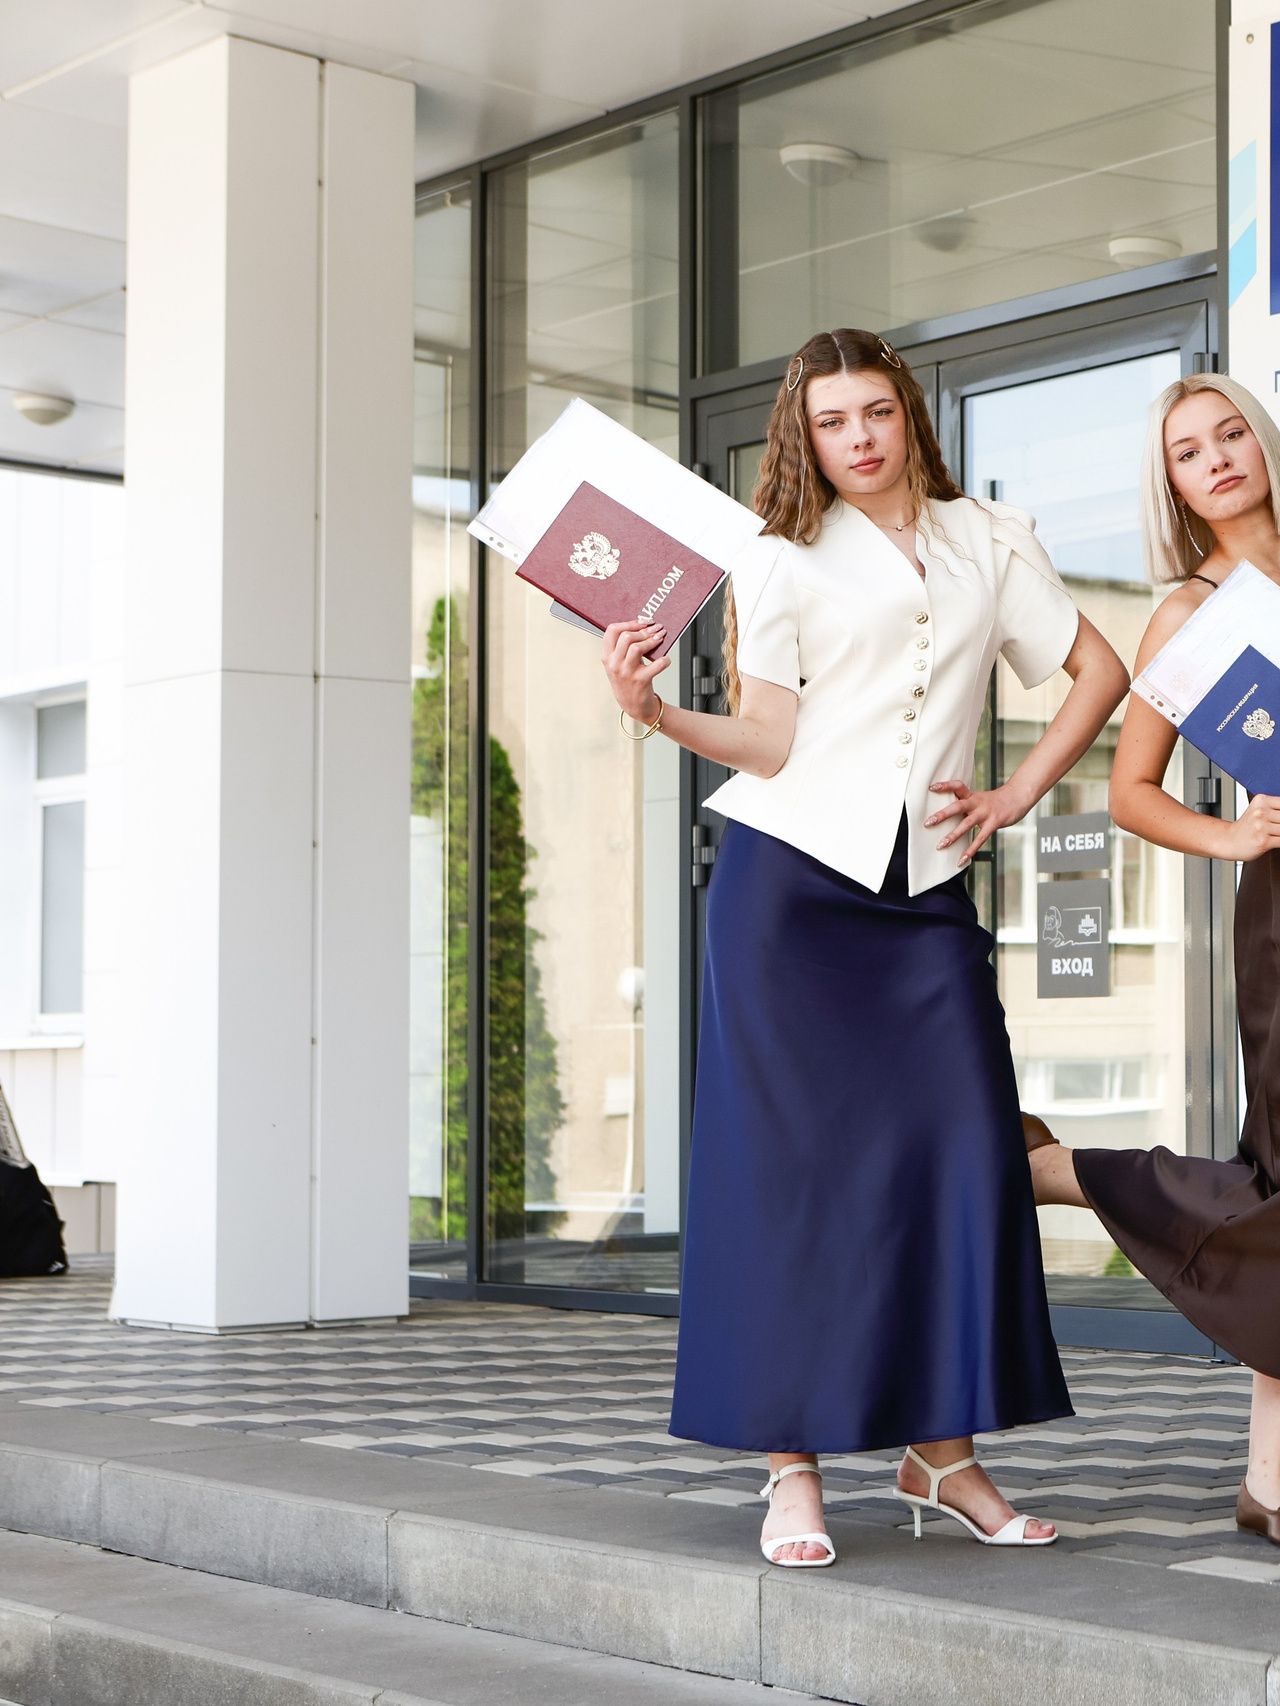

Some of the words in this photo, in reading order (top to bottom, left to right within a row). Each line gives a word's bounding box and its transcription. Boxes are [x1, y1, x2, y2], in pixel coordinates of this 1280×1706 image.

[1041, 836, 1062, 853] НА
[1065, 832, 1105, 852] СЕБЯ
[1052, 957, 1093, 976] ВХОД
